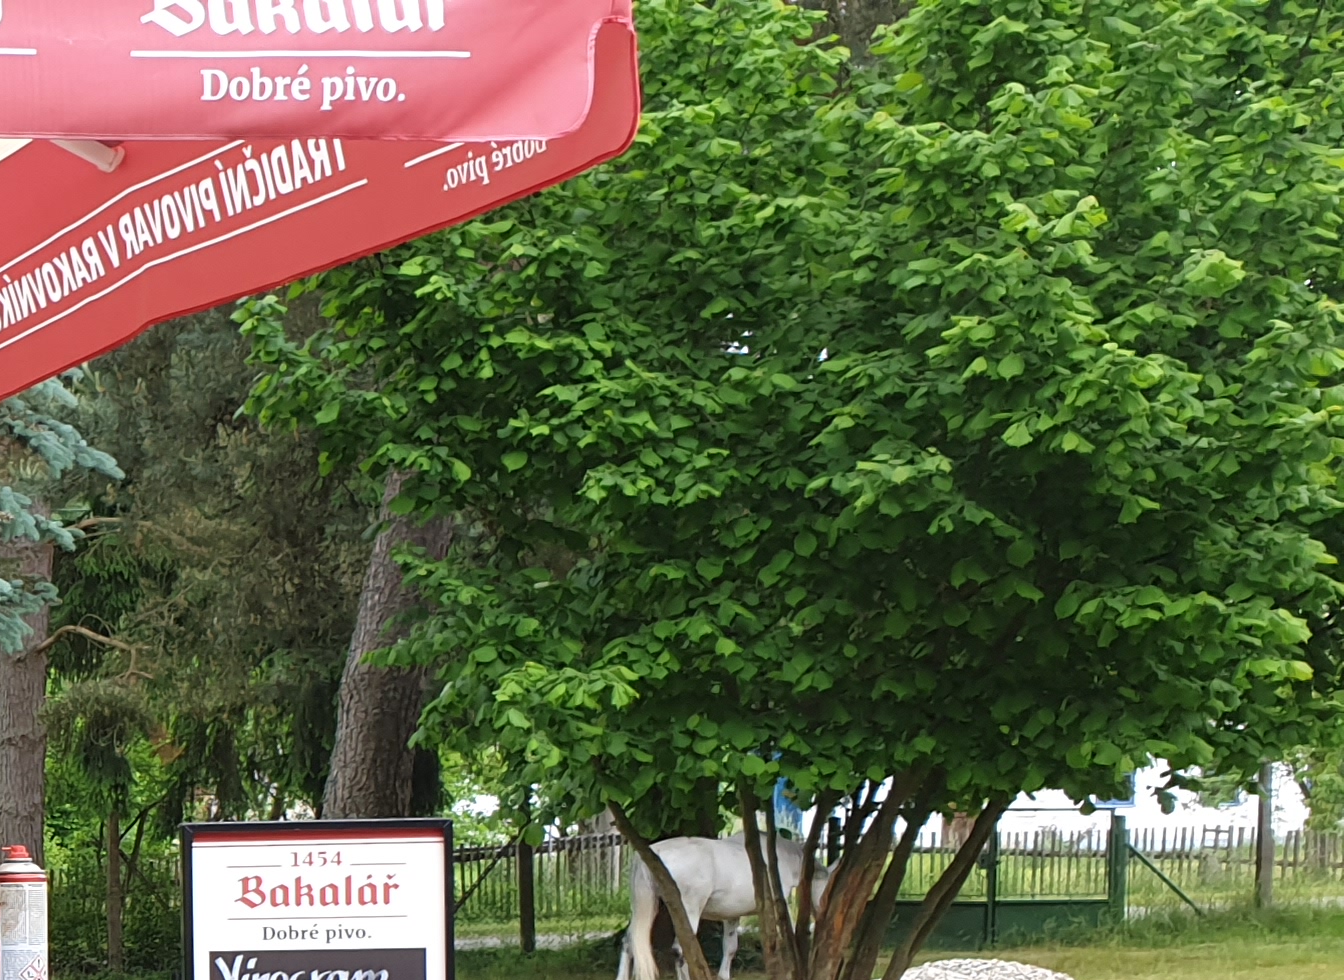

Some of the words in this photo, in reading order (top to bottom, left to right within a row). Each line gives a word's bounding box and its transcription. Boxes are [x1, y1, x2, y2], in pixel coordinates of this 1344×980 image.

[200, 63, 311, 102] Dobré
[320, 65, 406, 111] pivo.
[290, 850, 343, 867] 1454
[234, 873, 400, 909] Bakalář
[262, 923, 319, 941] Dobré
[326, 924, 373, 944] pivo.
